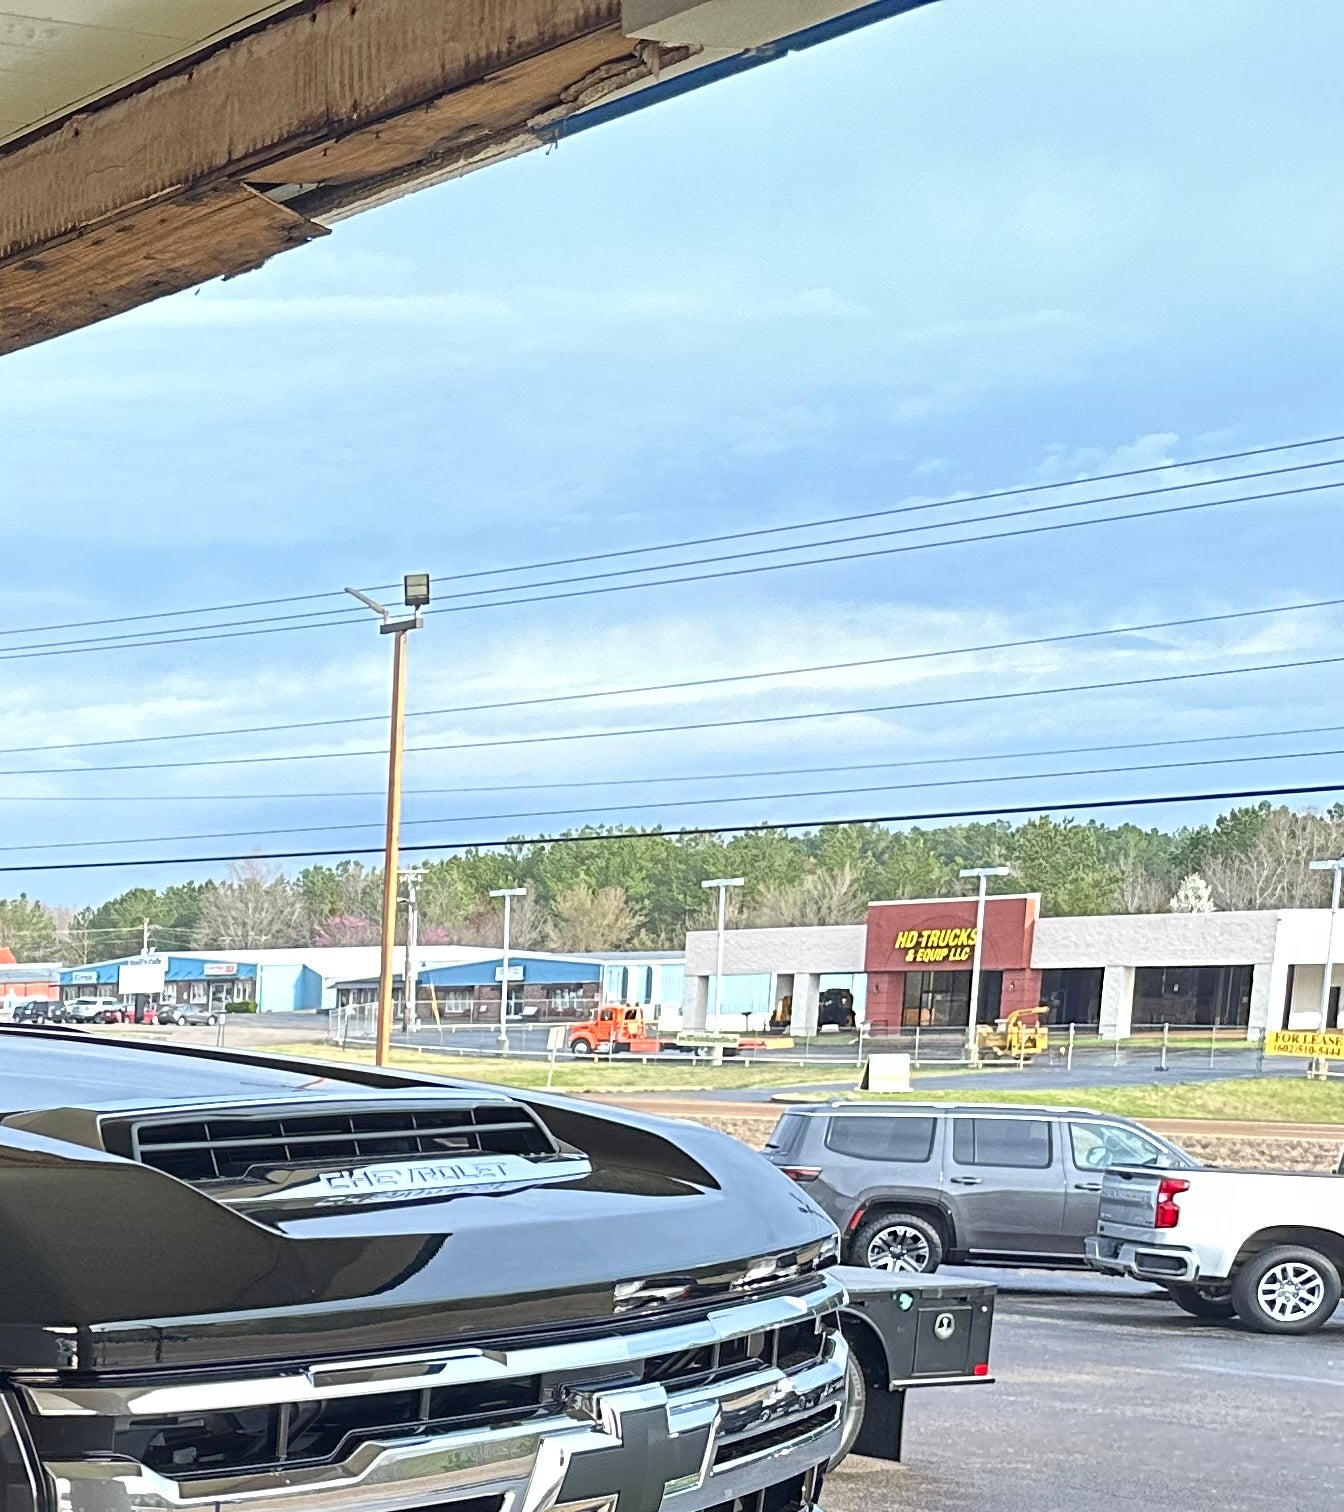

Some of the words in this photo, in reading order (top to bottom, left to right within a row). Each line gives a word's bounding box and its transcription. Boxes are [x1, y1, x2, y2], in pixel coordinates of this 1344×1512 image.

[916, 948, 949, 963] EQUIP
[949, 947, 970, 961] LLC
[1275, 1032, 1300, 1044] FOR
[1303, 1034, 1343, 1047] LEASE
